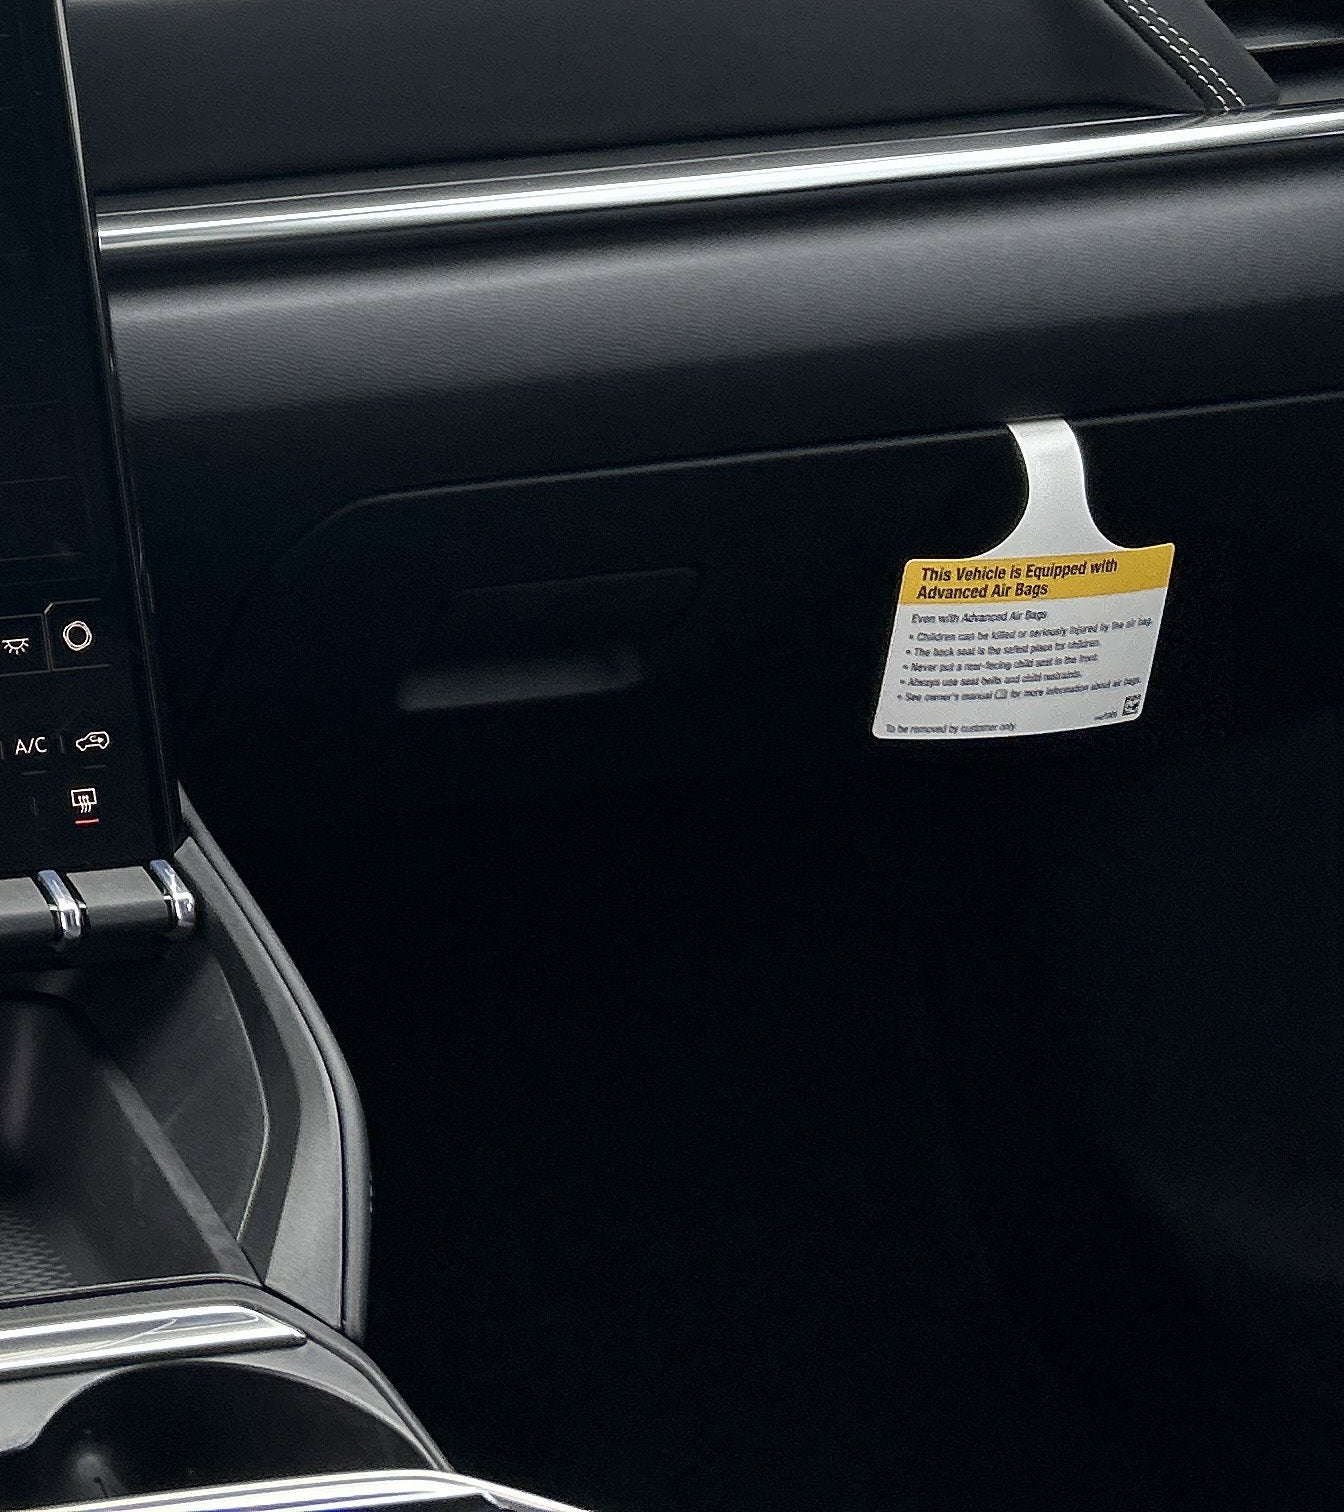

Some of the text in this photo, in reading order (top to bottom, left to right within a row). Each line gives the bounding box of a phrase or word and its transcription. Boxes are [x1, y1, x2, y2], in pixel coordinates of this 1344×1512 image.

[921, 558, 1118, 582] This Vehicle is Equipped with
[916, 582, 1048, 600] Advanced Air Bags
[14, 736, 48, 756] A/C
